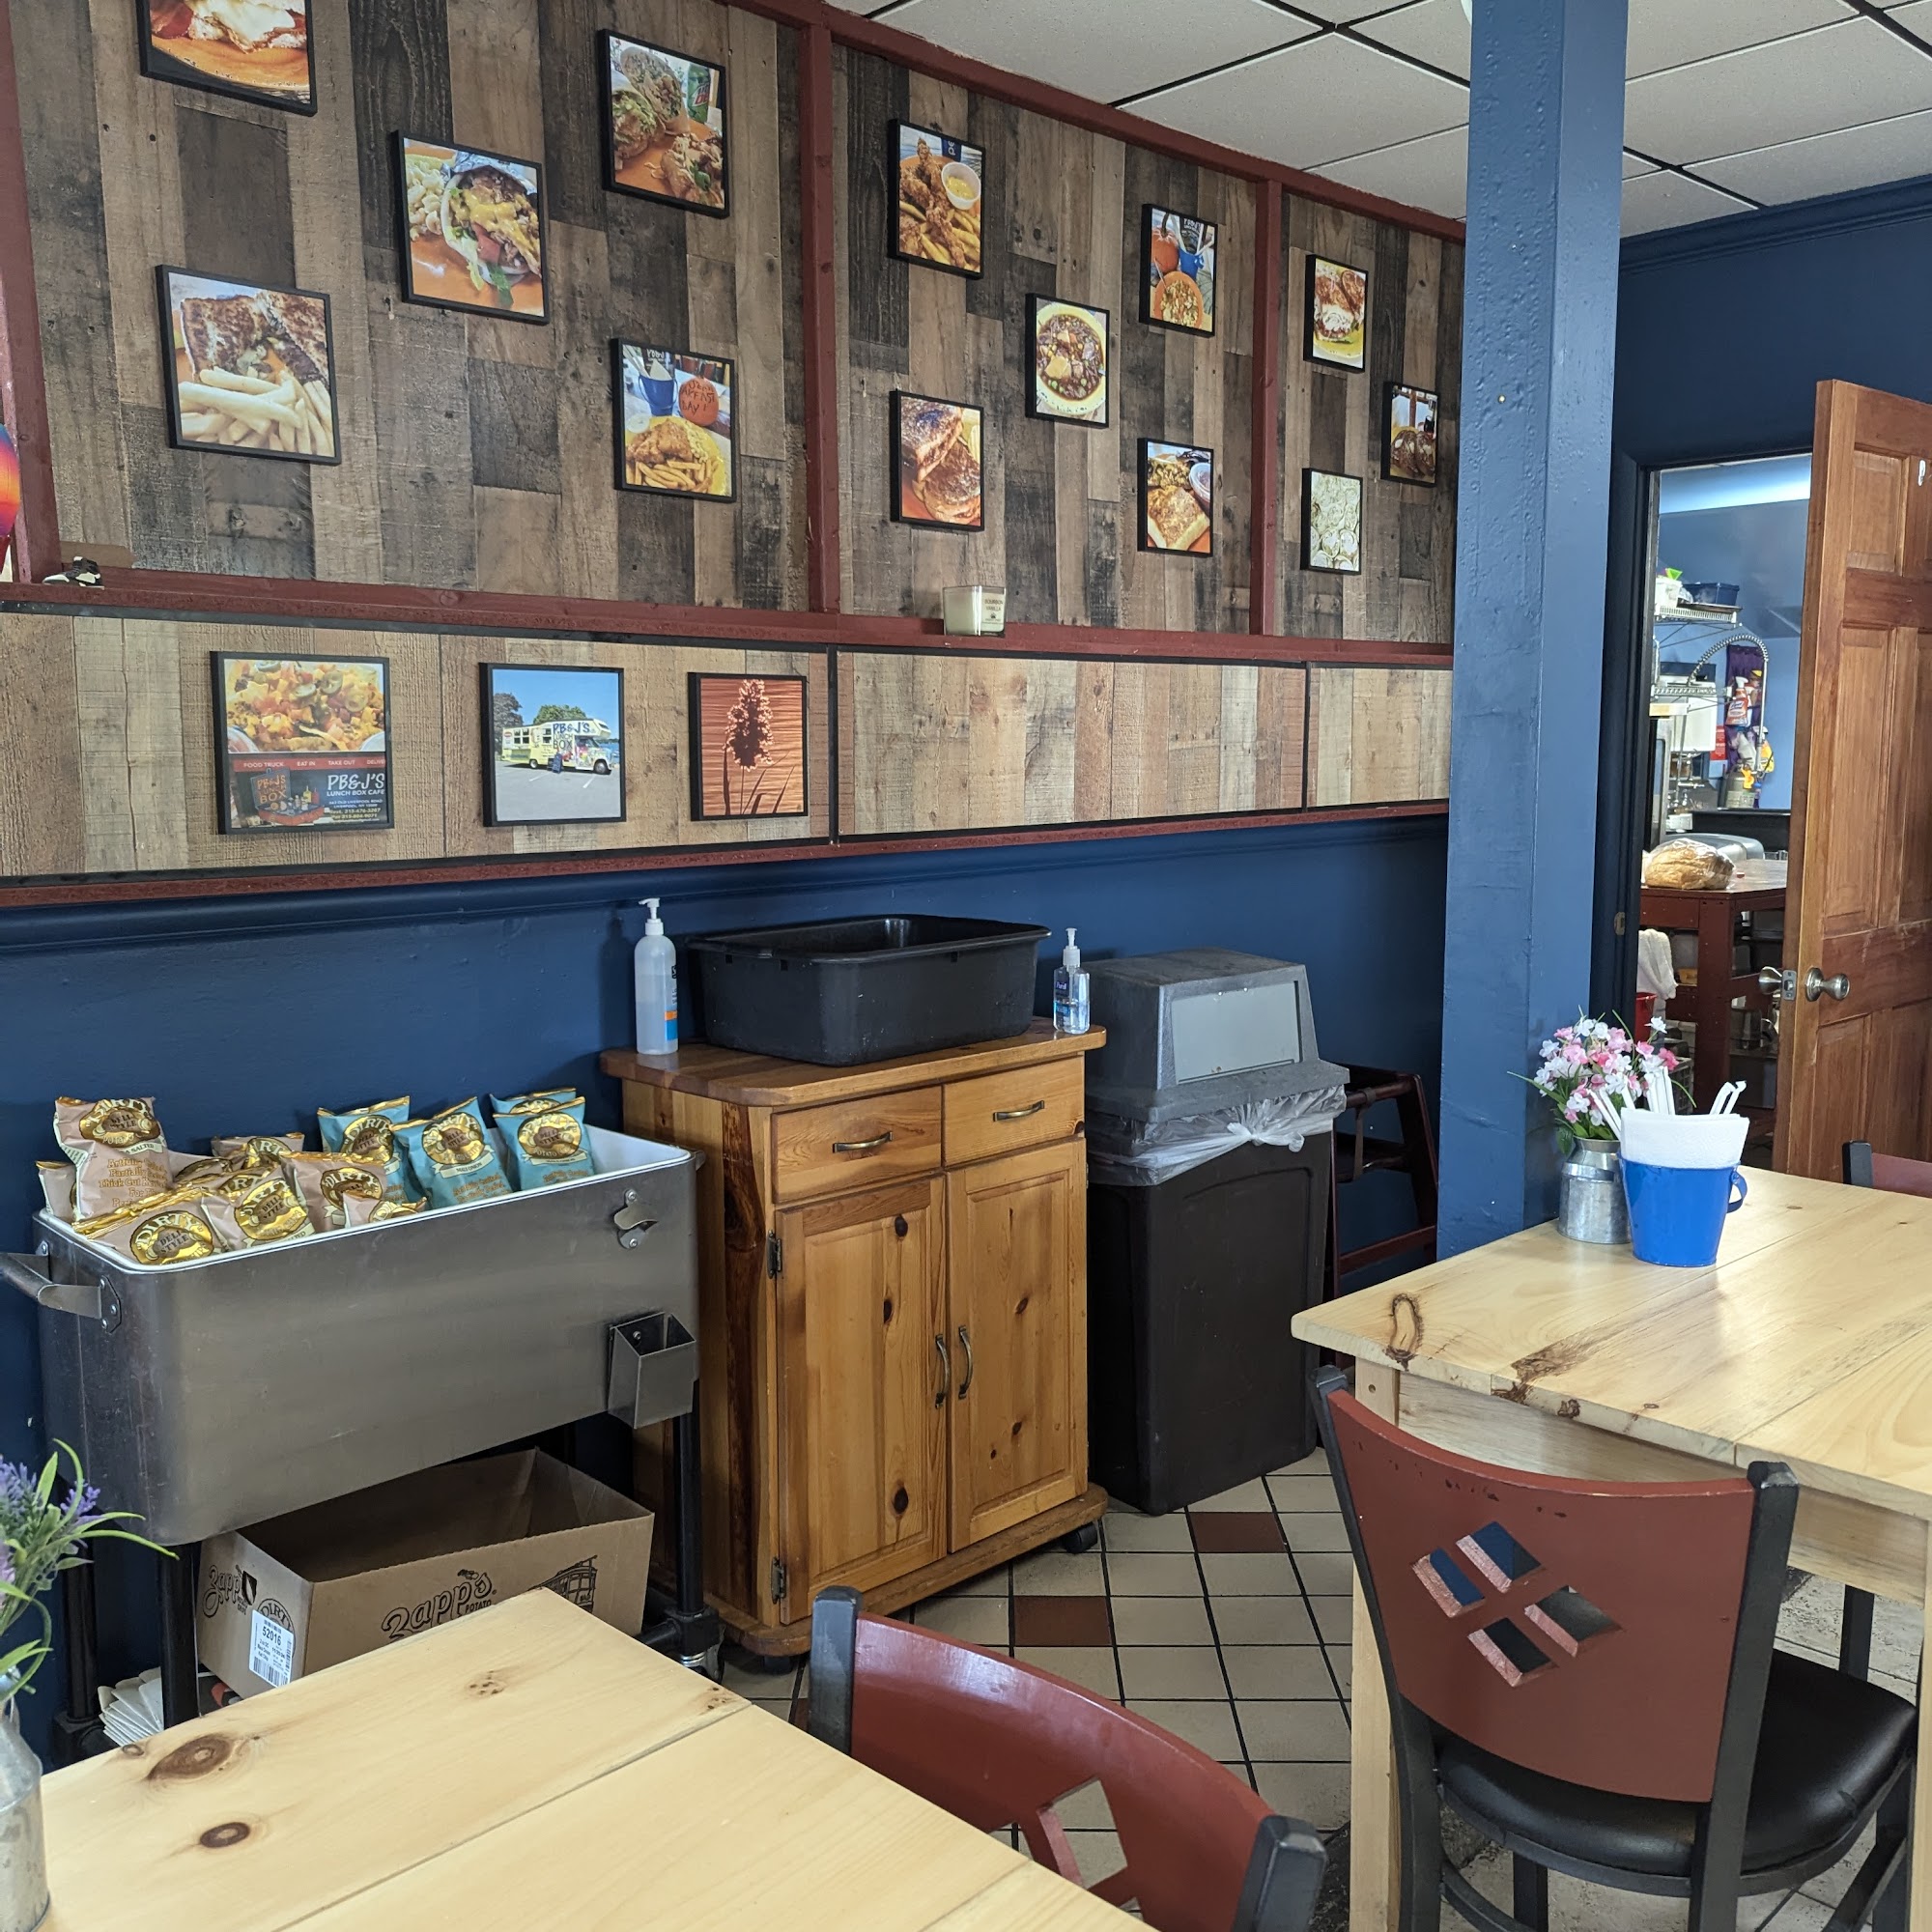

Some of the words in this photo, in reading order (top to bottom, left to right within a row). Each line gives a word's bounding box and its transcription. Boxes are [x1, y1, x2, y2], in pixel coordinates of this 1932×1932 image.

[554, 740, 573, 750] BOX
[327, 773, 385, 791] PB&J'S
[260, 789, 288, 804] BOX
[131, 1143, 155, 1152] SALTED
[99, 1179, 124, 1188] Thick
[125, 1178, 141, 1186] Cut
[159, 1230, 182, 1246] DELI
[160, 1235, 189, 1253] STYLE
[465, 1599, 492, 1614] POTATO
[262, 1625, 282, 1646] 52016
